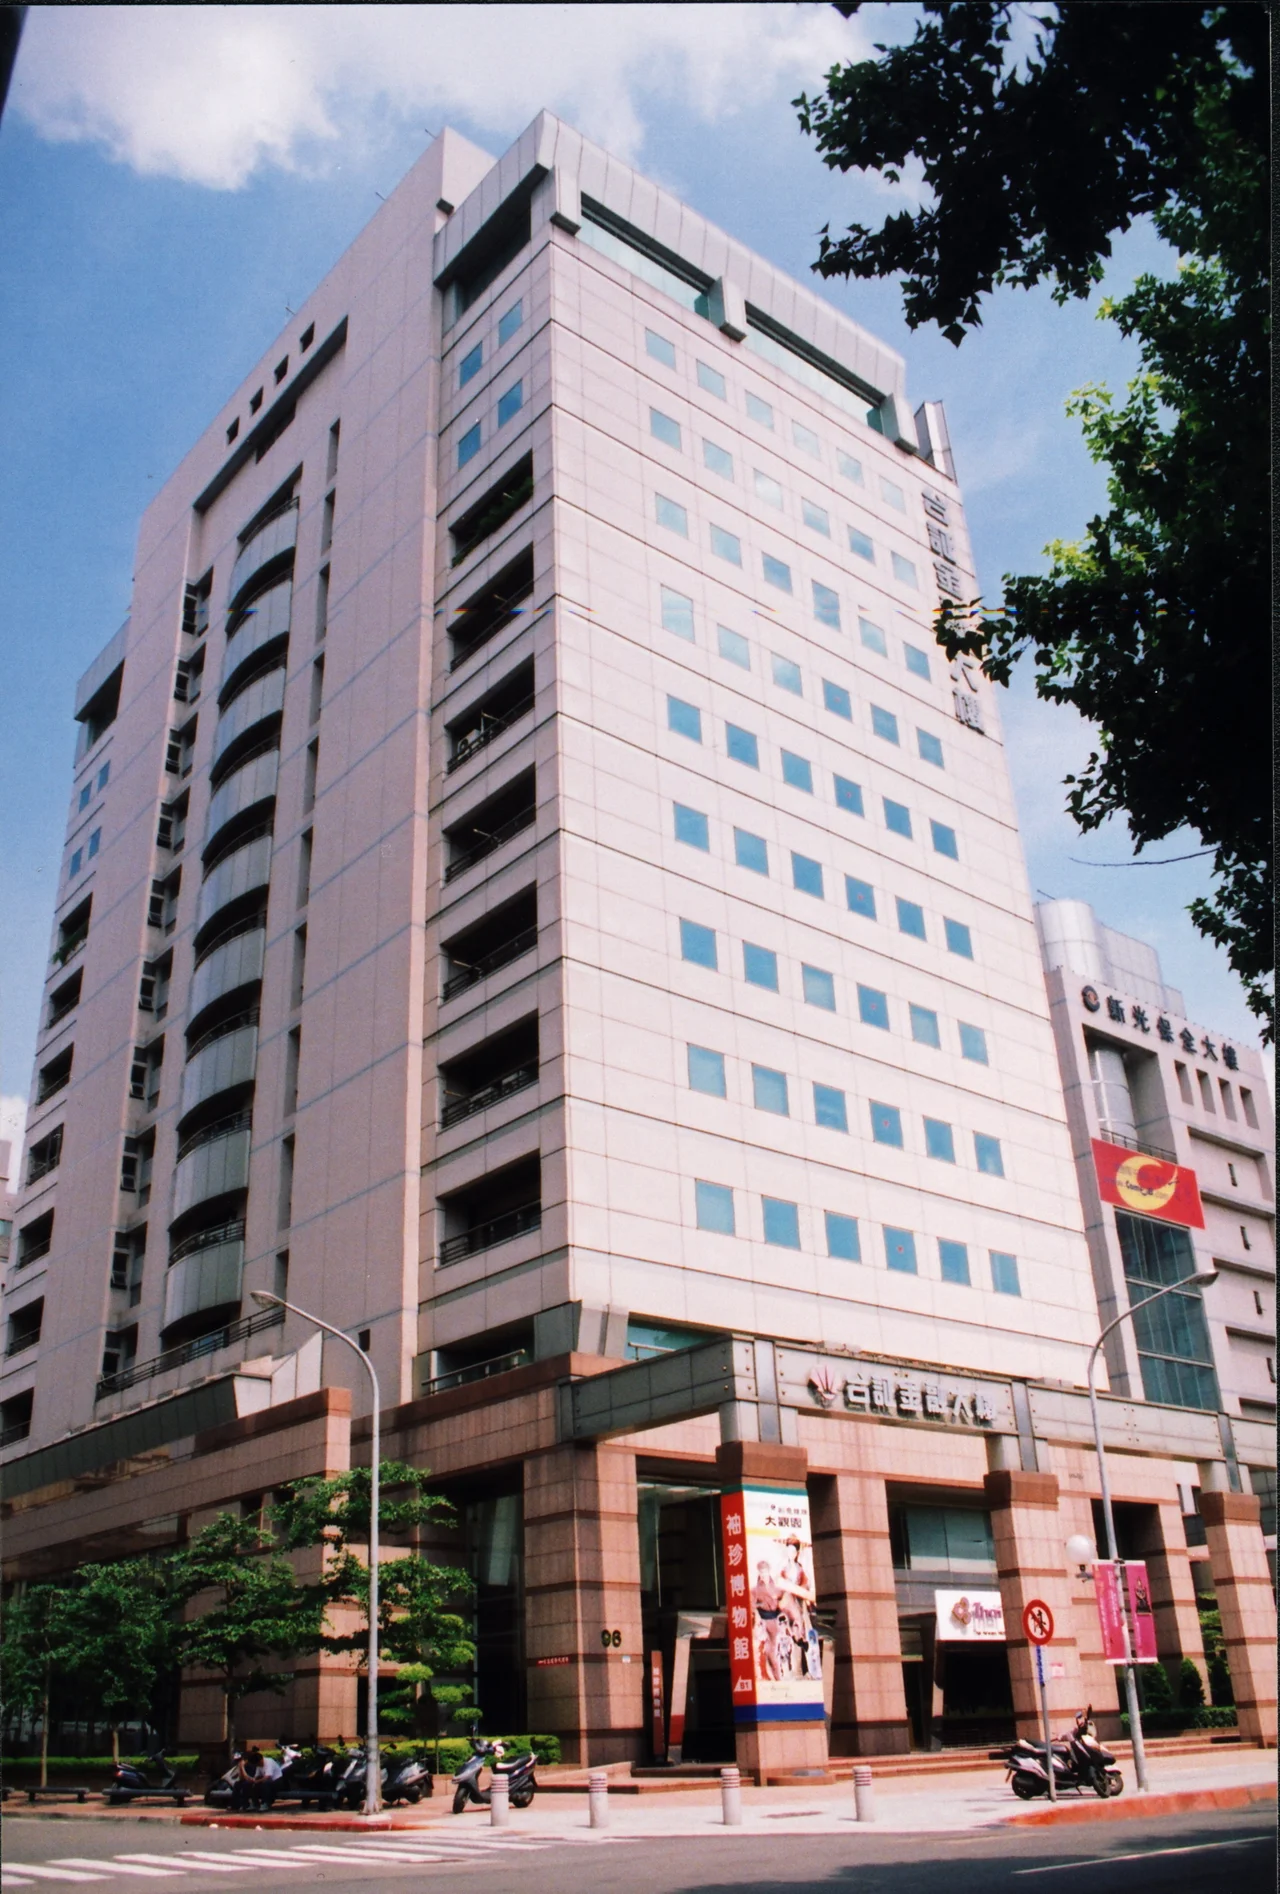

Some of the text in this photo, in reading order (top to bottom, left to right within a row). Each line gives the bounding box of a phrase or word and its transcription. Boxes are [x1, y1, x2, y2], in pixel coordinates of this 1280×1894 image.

[1106, 995, 1239, 1071] 新光保全大樓
[725, 1512, 750, 1661] 袖珍博物館
